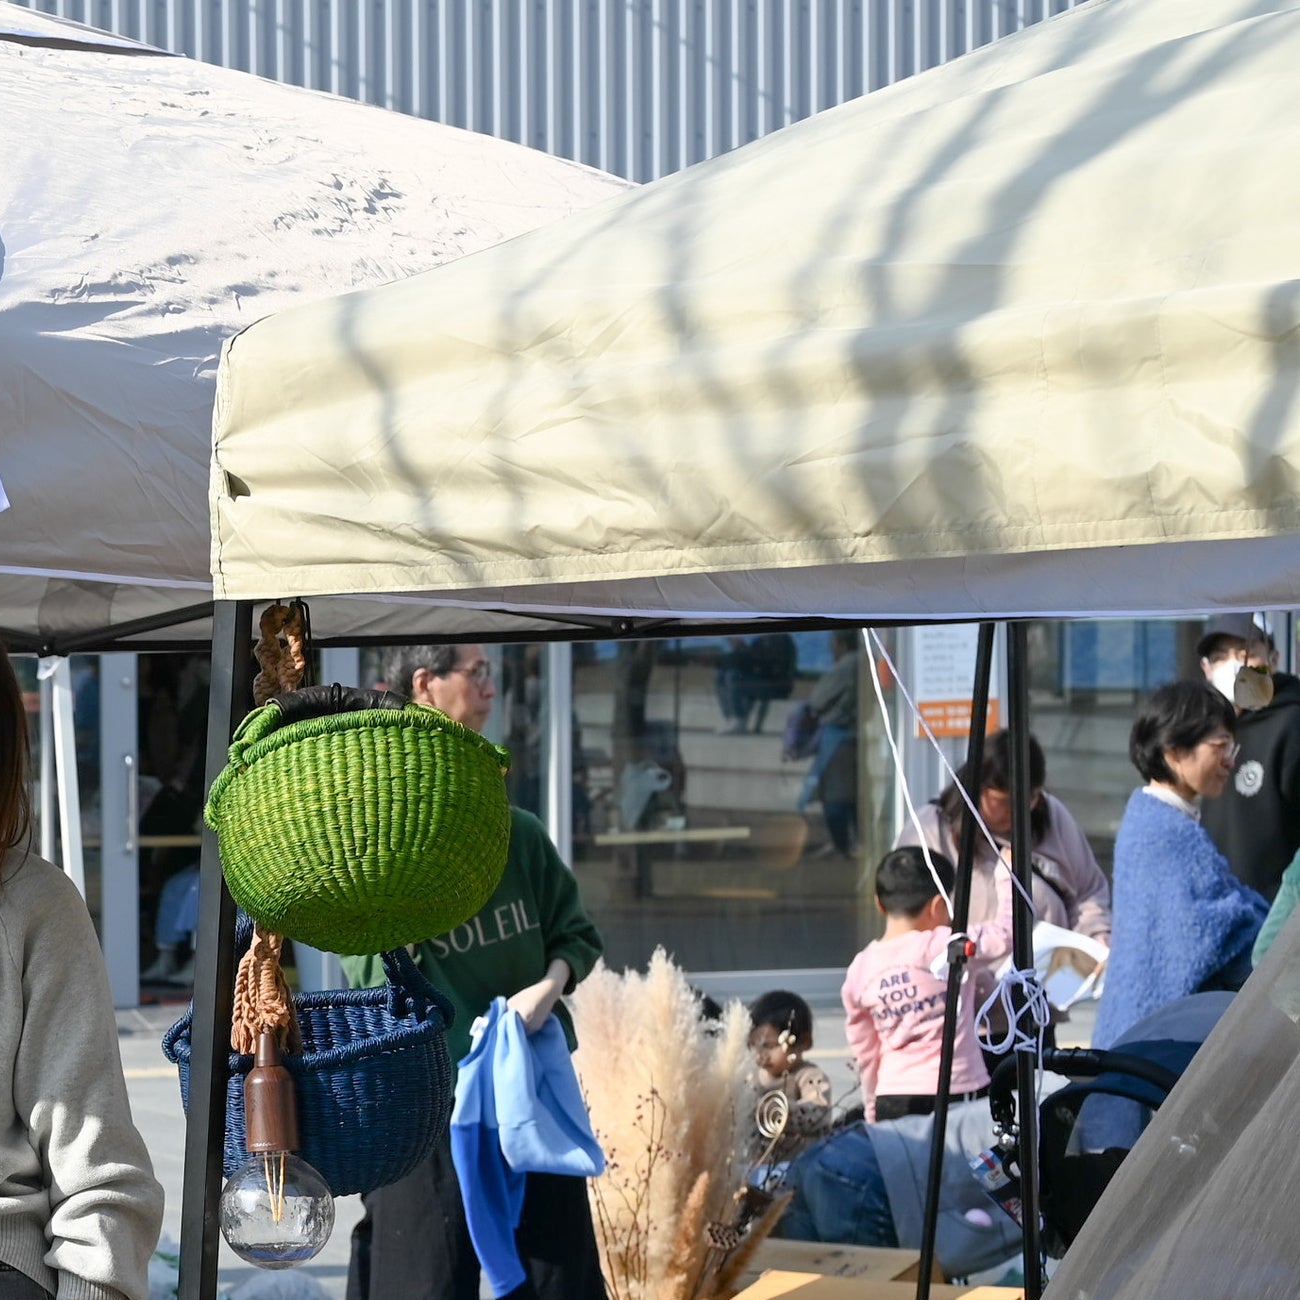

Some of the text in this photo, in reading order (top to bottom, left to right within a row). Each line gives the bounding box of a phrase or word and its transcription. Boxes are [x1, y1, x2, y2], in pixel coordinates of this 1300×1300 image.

[431, 899, 540, 959] SOLEIL
[880, 972, 910, 990] ARE
[878, 986, 917, 1005] YOU
